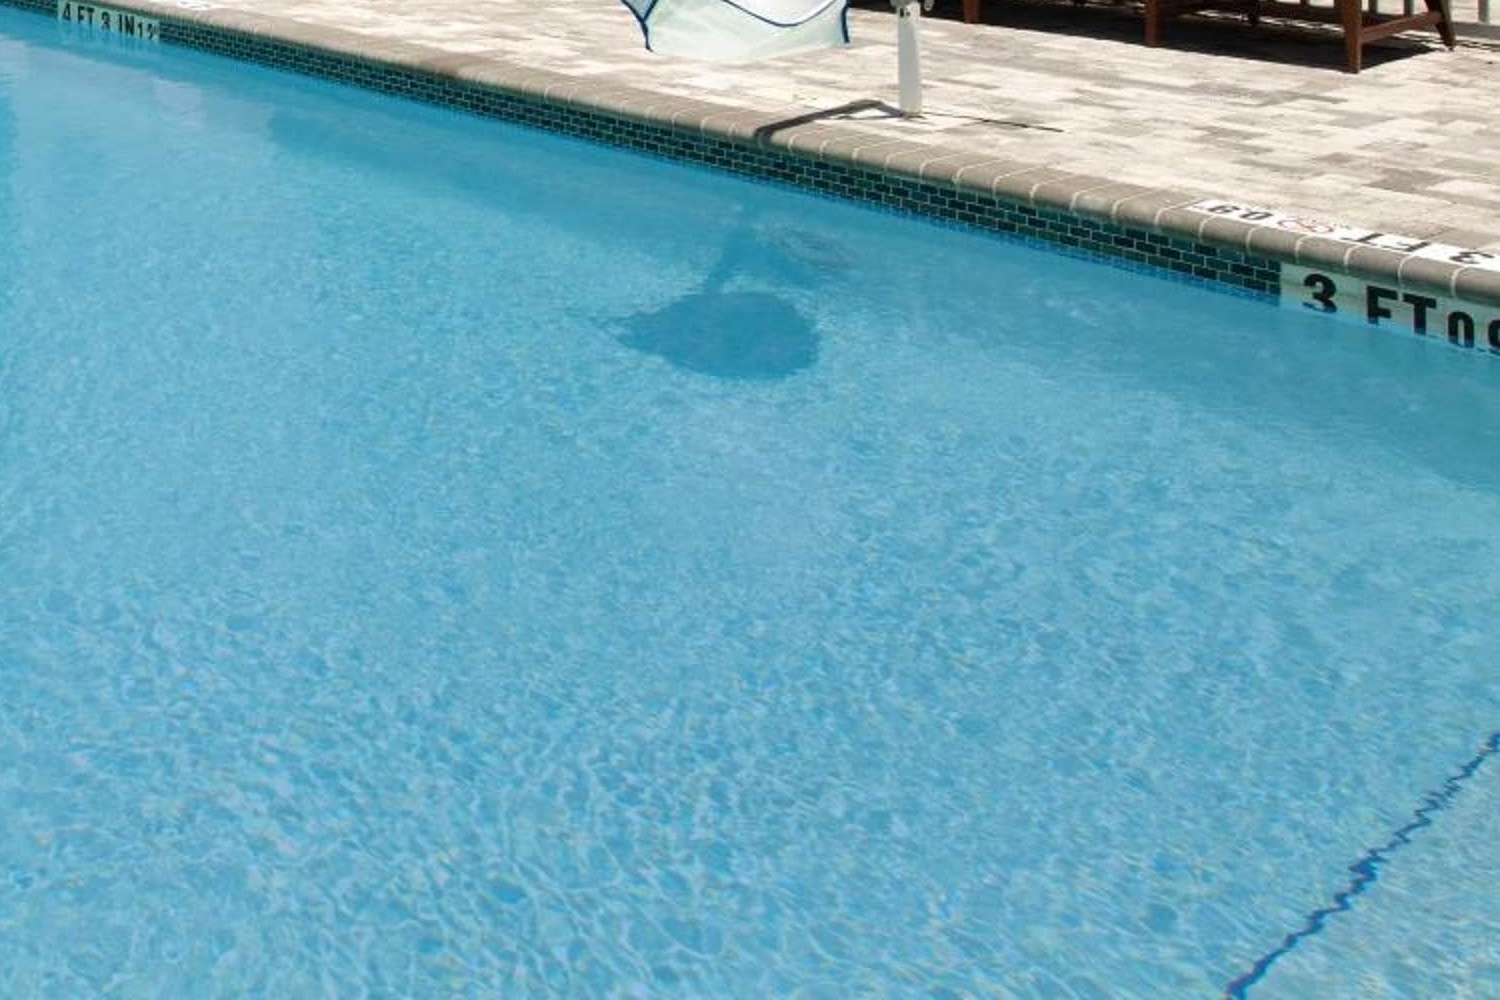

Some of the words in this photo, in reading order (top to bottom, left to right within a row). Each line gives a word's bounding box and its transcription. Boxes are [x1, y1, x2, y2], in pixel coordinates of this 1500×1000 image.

[62, 3, 71, 21] 4
[77, 5, 95, 25] FT
[118, 14, 135, 36] IN
[1303, 273, 1338, 314] 3
[1366, 285, 1438, 336] FT
